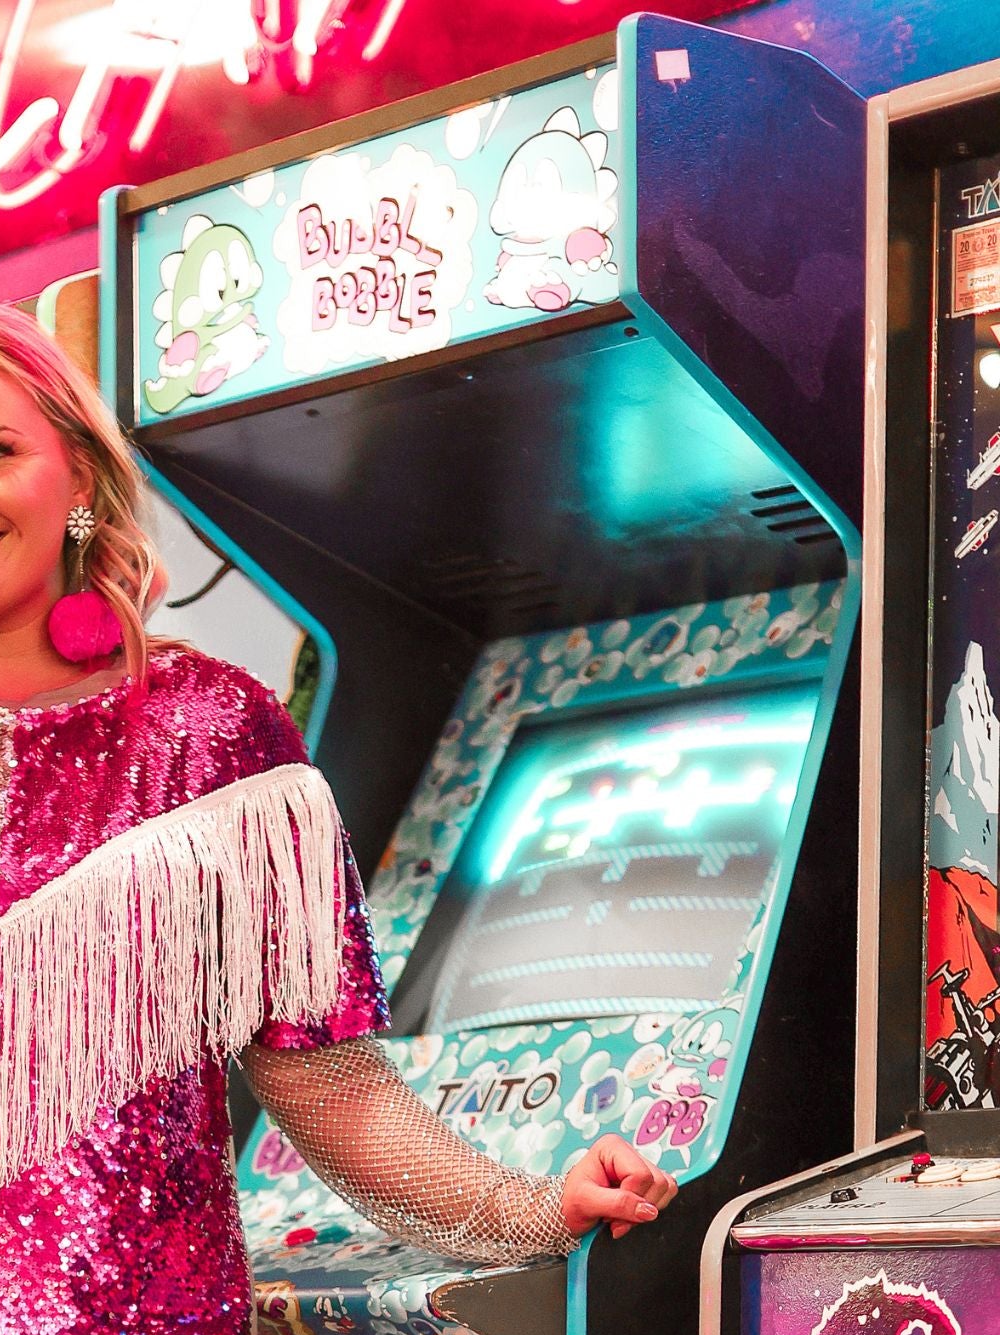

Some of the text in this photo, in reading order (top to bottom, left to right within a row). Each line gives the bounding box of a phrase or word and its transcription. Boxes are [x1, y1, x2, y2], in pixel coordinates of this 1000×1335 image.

[960, 233, 997, 253] 20 20
[311, 256, 437, 335] BOBBLE
[436, 1061, 559, 1117] TAITO
